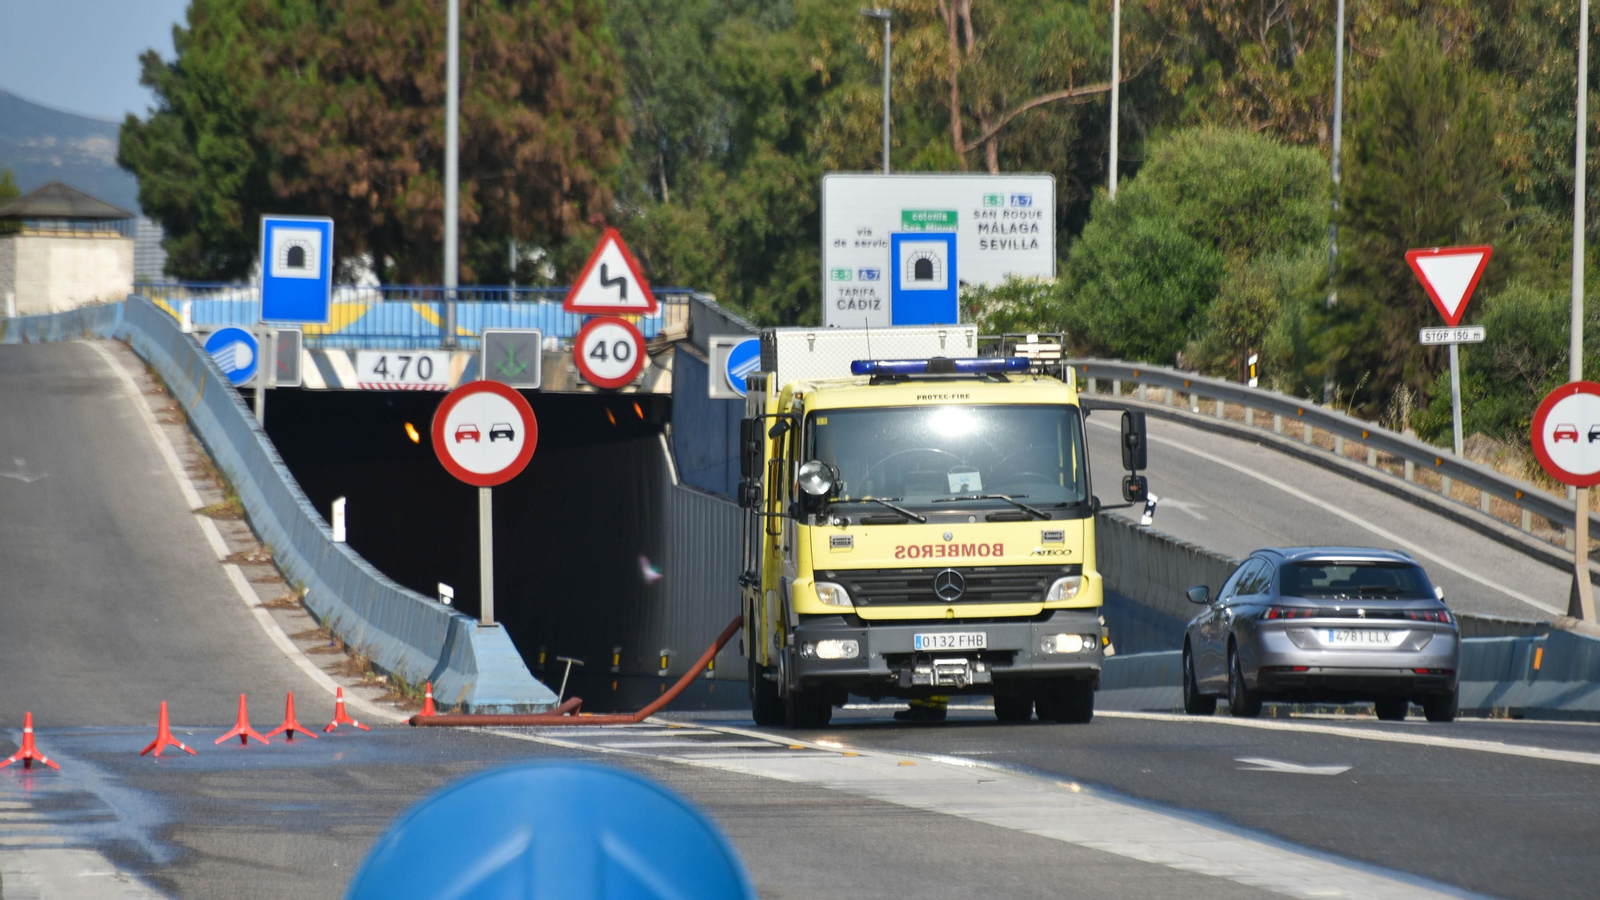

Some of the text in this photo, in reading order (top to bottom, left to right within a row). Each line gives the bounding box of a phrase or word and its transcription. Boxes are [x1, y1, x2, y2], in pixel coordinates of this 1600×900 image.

[984, 194, 1032, 207] E-5 A-7
[912, 211, 948, 222] colonia
[973, 209, 1043, 220] SAN ROQUE
[978, 221, 1040, 235] MÁLAGA
[833, 238, 888, 248] de servic
[979, 238, 1039, 251] SEVILLA
[831, 269, 880, 281] E-5 A-7
[839, 288, 876, 298] TARIFA
[837, 297, 882, 311] CÁDIZ
[1425, 329, 1481, 342] STOP 150 m
[589, 340, 631, 363] 40
[916, 393, 971, 401] PROTEC-FIRE
[922, 634, 984, 649] 0132 FHB
[1336, 630, 1391, 643] 4781 LLX
